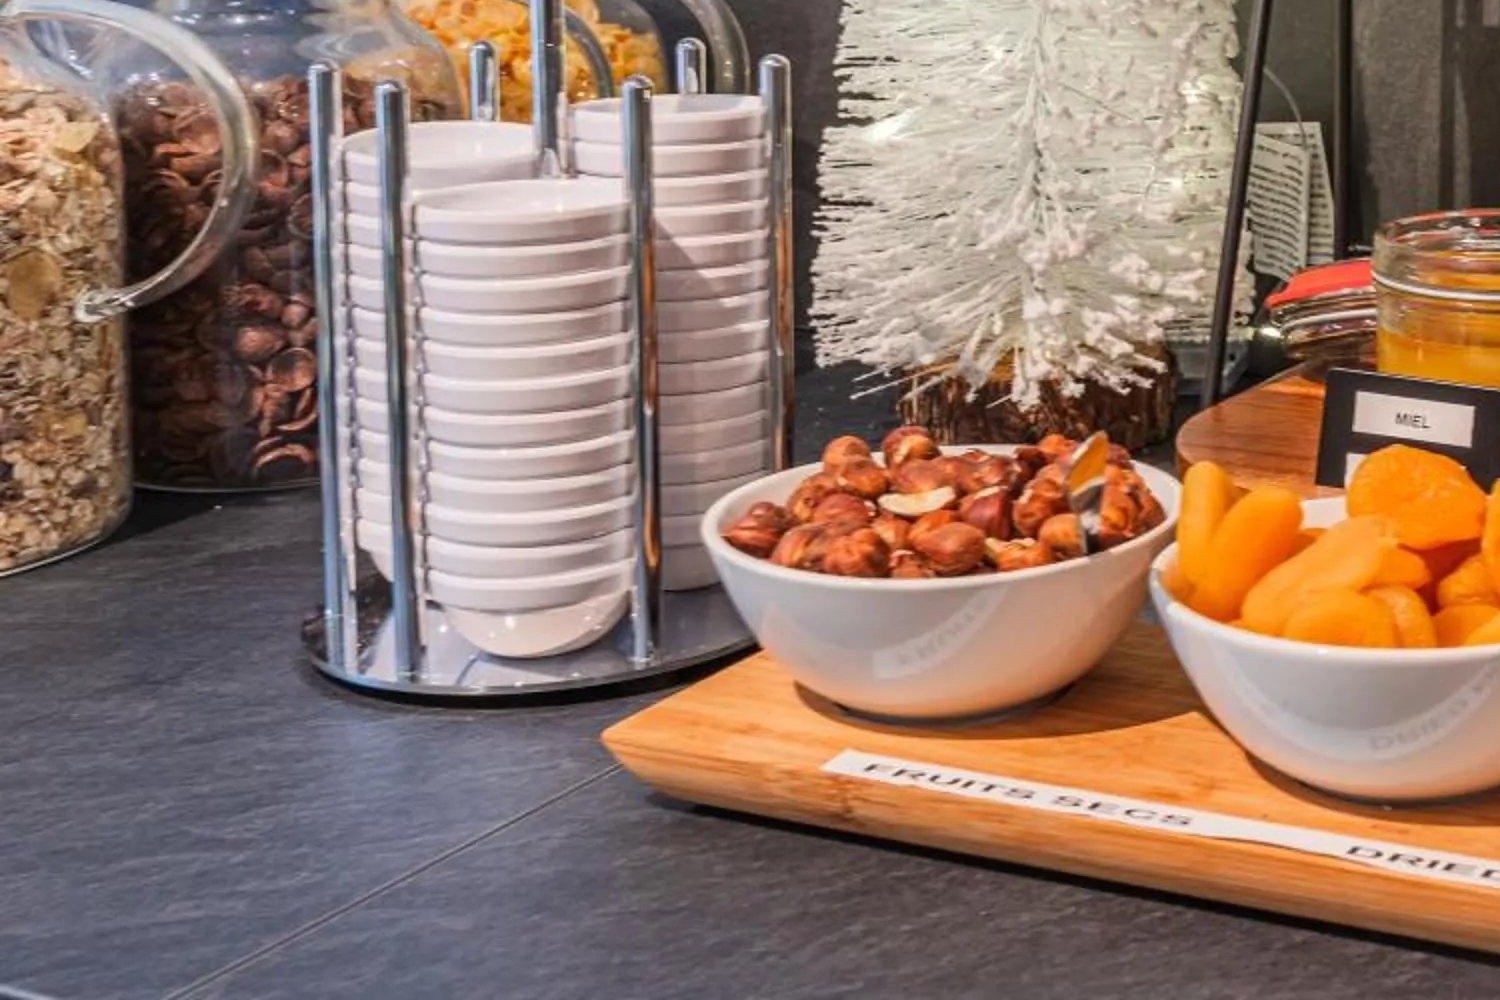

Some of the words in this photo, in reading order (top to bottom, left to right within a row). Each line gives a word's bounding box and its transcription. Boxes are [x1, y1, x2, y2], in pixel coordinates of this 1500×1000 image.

[1395, 412, 1432, 430] MIEL
[863, 763, 1037, 801] FRUITS
[1051, 794, 1192, 827] SECS
